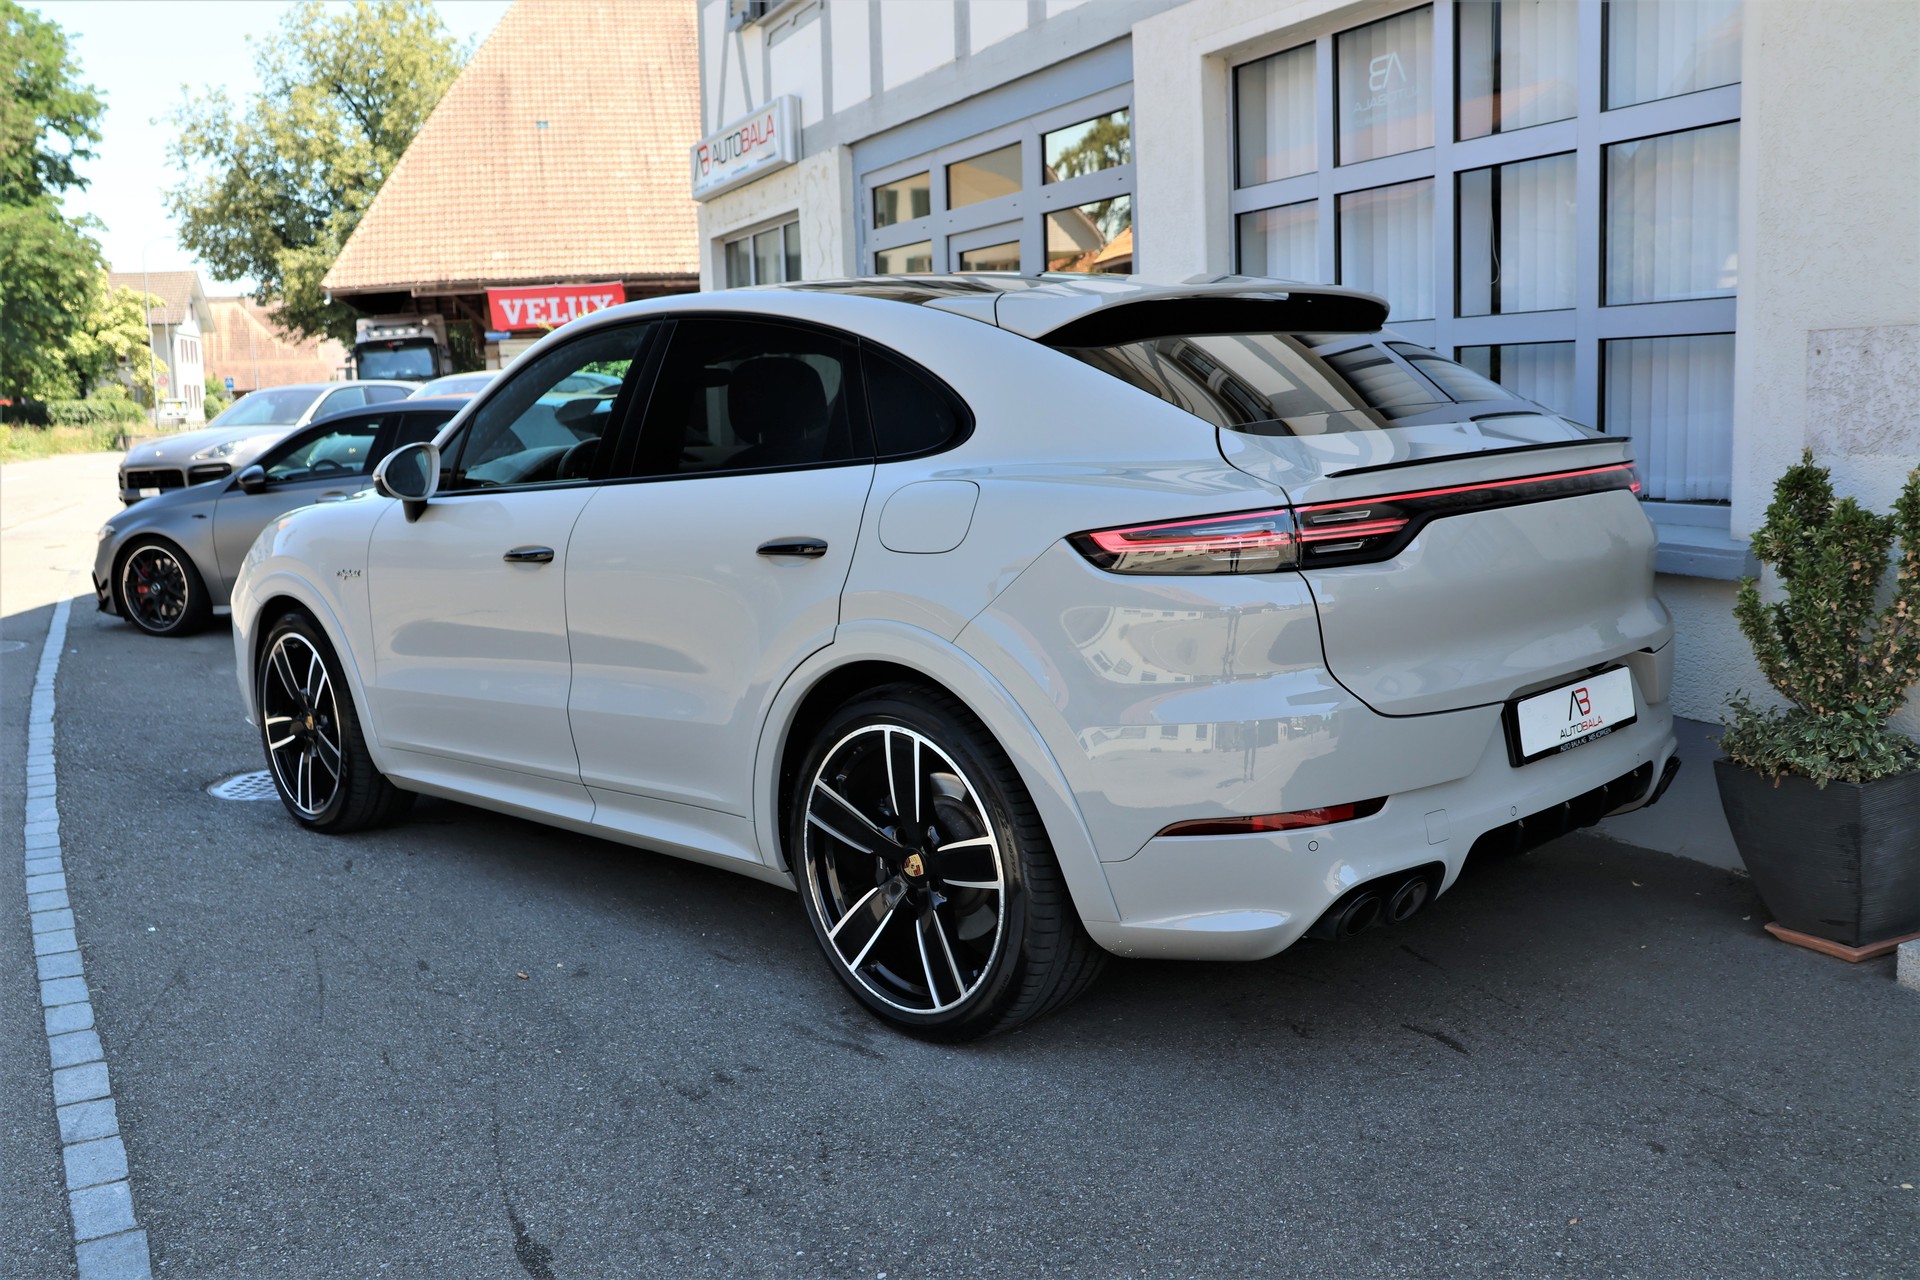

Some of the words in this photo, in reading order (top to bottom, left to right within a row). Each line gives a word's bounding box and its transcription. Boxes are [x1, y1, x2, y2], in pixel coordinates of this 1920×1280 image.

[712, 114, 775, 168] AUTOBALA
[498, 294, 613, 325] VELUX
[1560, 716, 1603, 739] AUTOBALA
